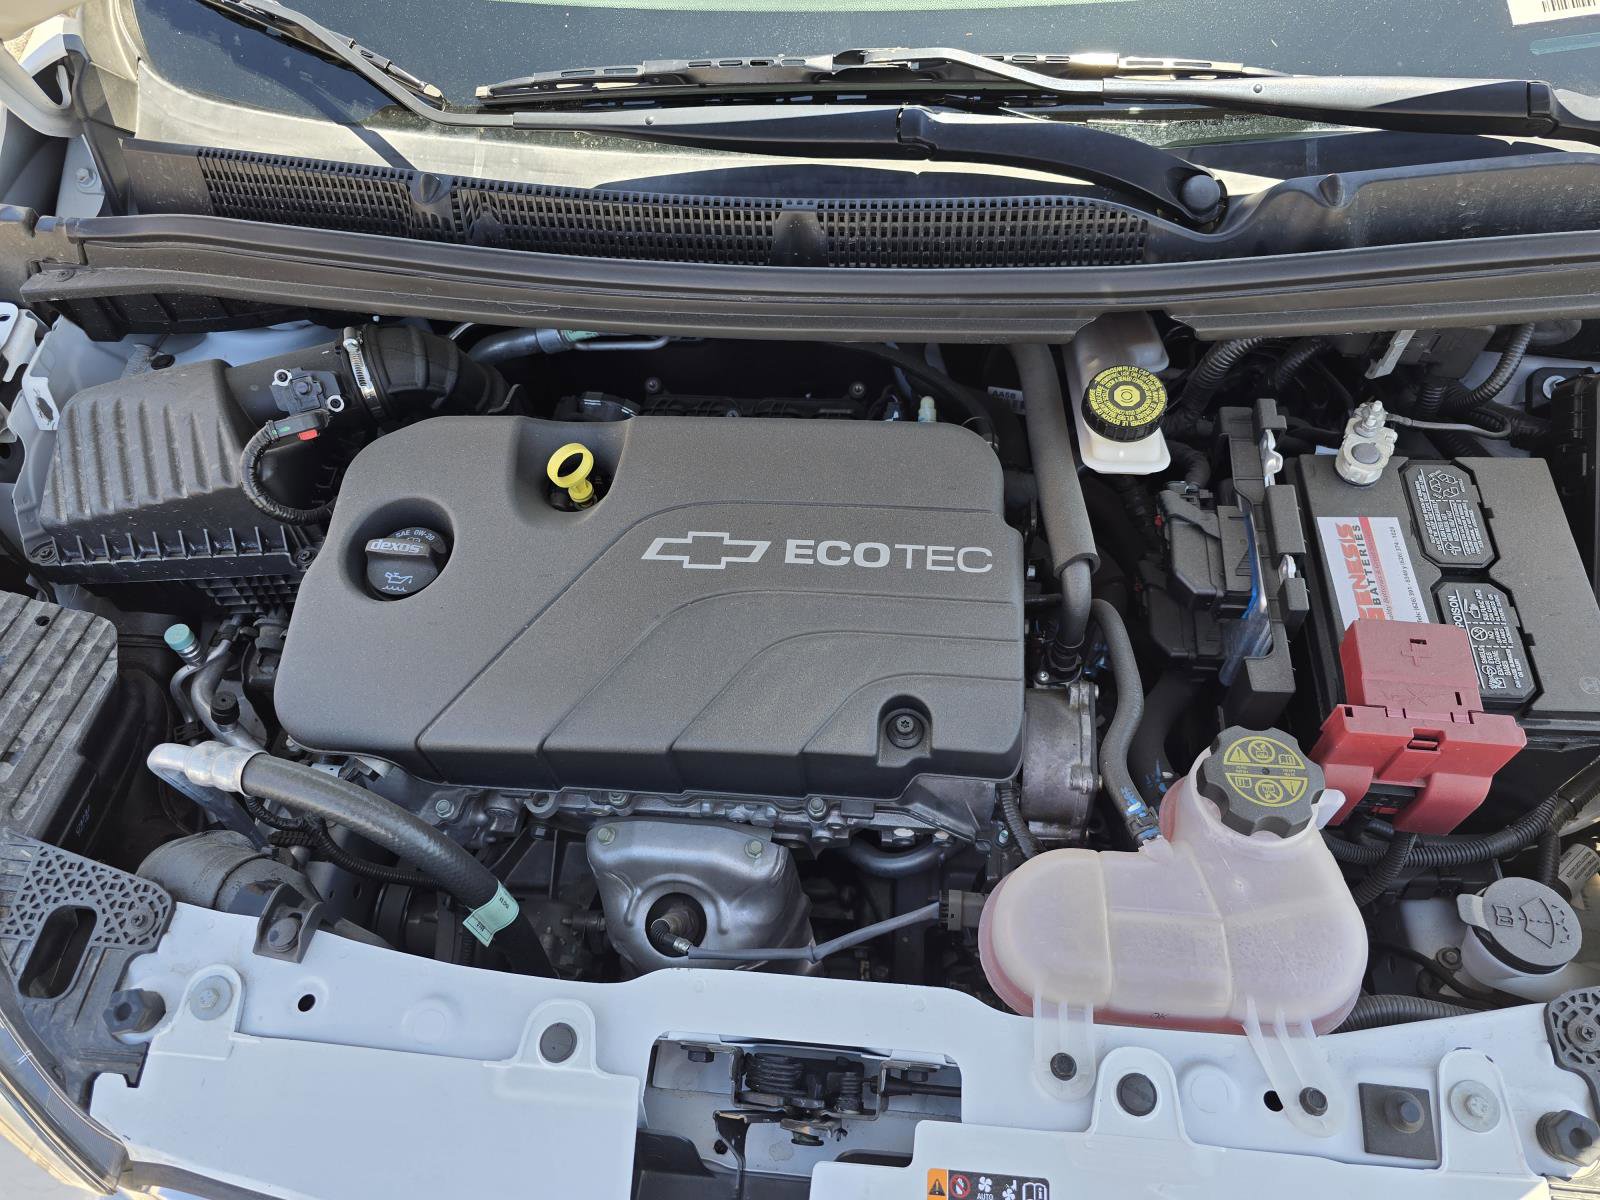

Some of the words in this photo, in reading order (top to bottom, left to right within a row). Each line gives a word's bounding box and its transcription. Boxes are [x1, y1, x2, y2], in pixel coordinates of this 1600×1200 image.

[370, 539, 420, 553] dexos
[414, 529, 436, 541] 0W-20
[784, 539, 993, 573] ECOTEC
[1353, 526, 1381, 605] BATTERIES
[1335, 521, 1385, 620] GENESIS
[1448, 596, 1463, 627] POISON
[1487, 631, 1494, 639] NO
[977, 1192, 994, 1200] AUTO
